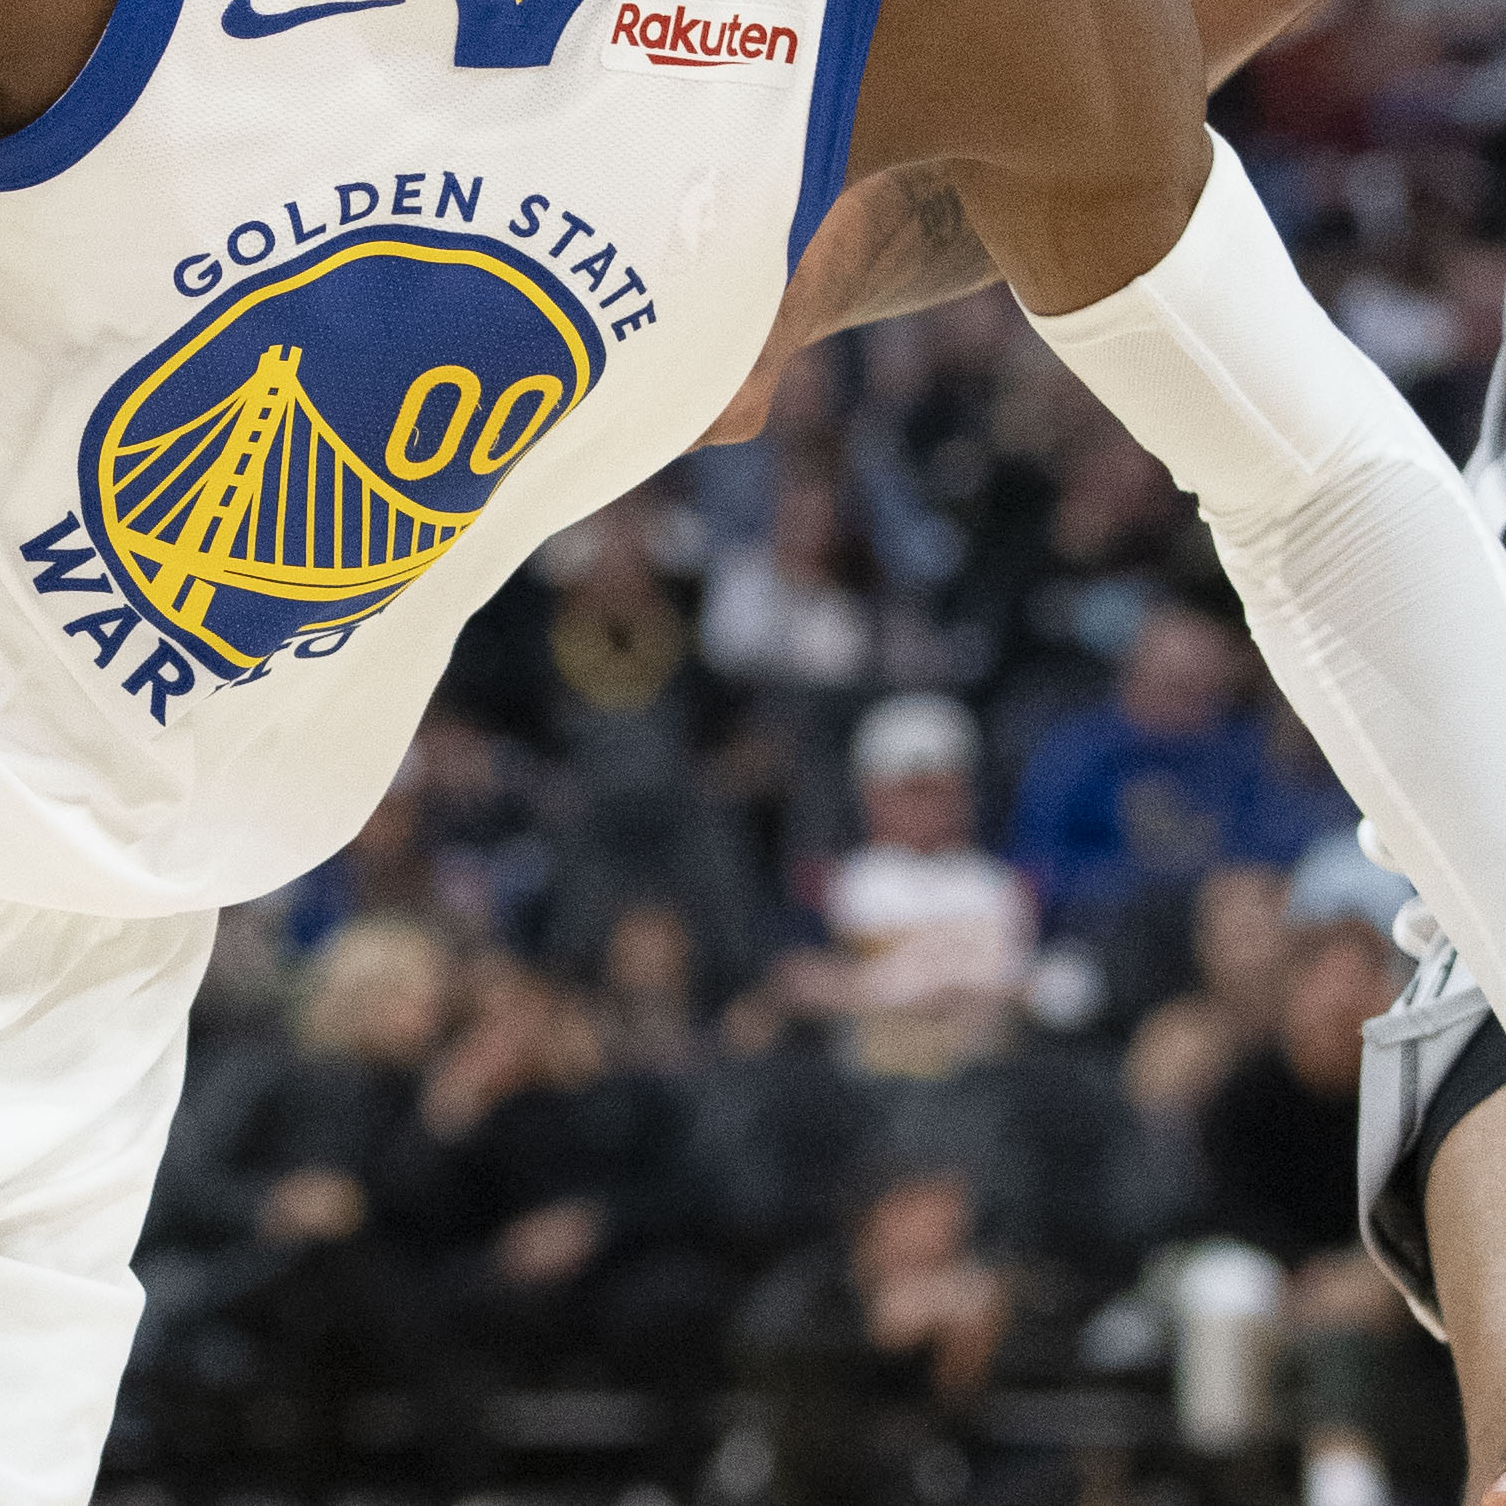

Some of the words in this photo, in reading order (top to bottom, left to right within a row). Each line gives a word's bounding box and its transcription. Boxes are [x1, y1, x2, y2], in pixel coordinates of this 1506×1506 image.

[610, 2, 798, 67] Rakuten
[173, 170, 484, 298] GOLDEN
[508, 193, 658, 343] STATE
[384, 364, 564, 482] 00
